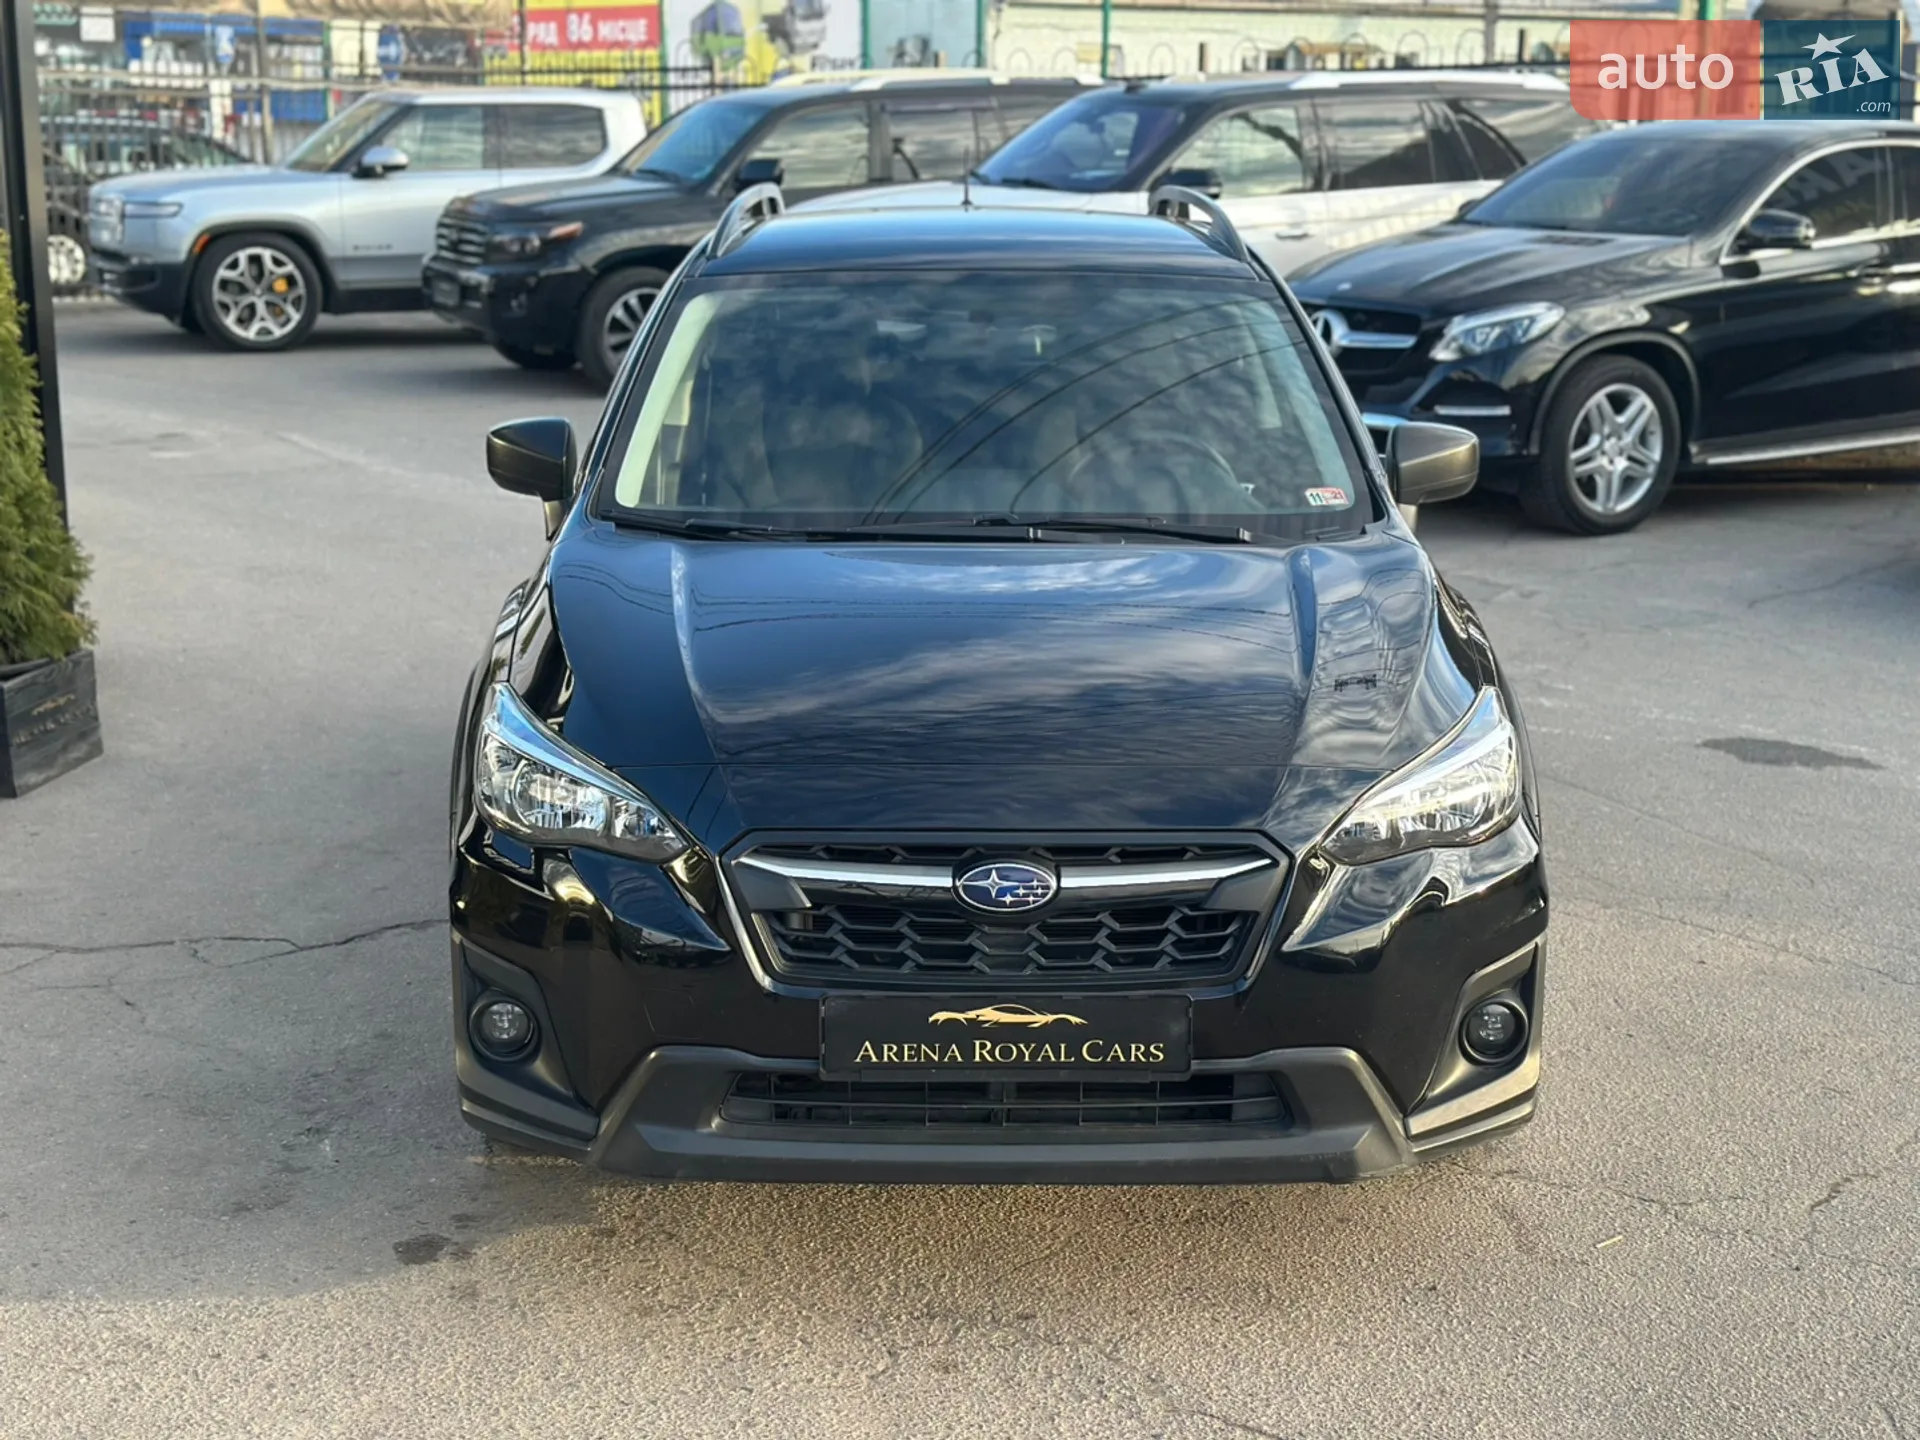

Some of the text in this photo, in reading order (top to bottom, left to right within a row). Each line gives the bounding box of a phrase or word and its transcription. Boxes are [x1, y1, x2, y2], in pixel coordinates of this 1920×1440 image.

[526, 20, 558, 45] РЯД
[566, 12, 593, 43] 86
[597, 18, 648, 42] МІСЦЕ
[1309, 492, 1323, 504] 11
[854, 1039, 1165, 1063] ARENA ROYAL CARS
